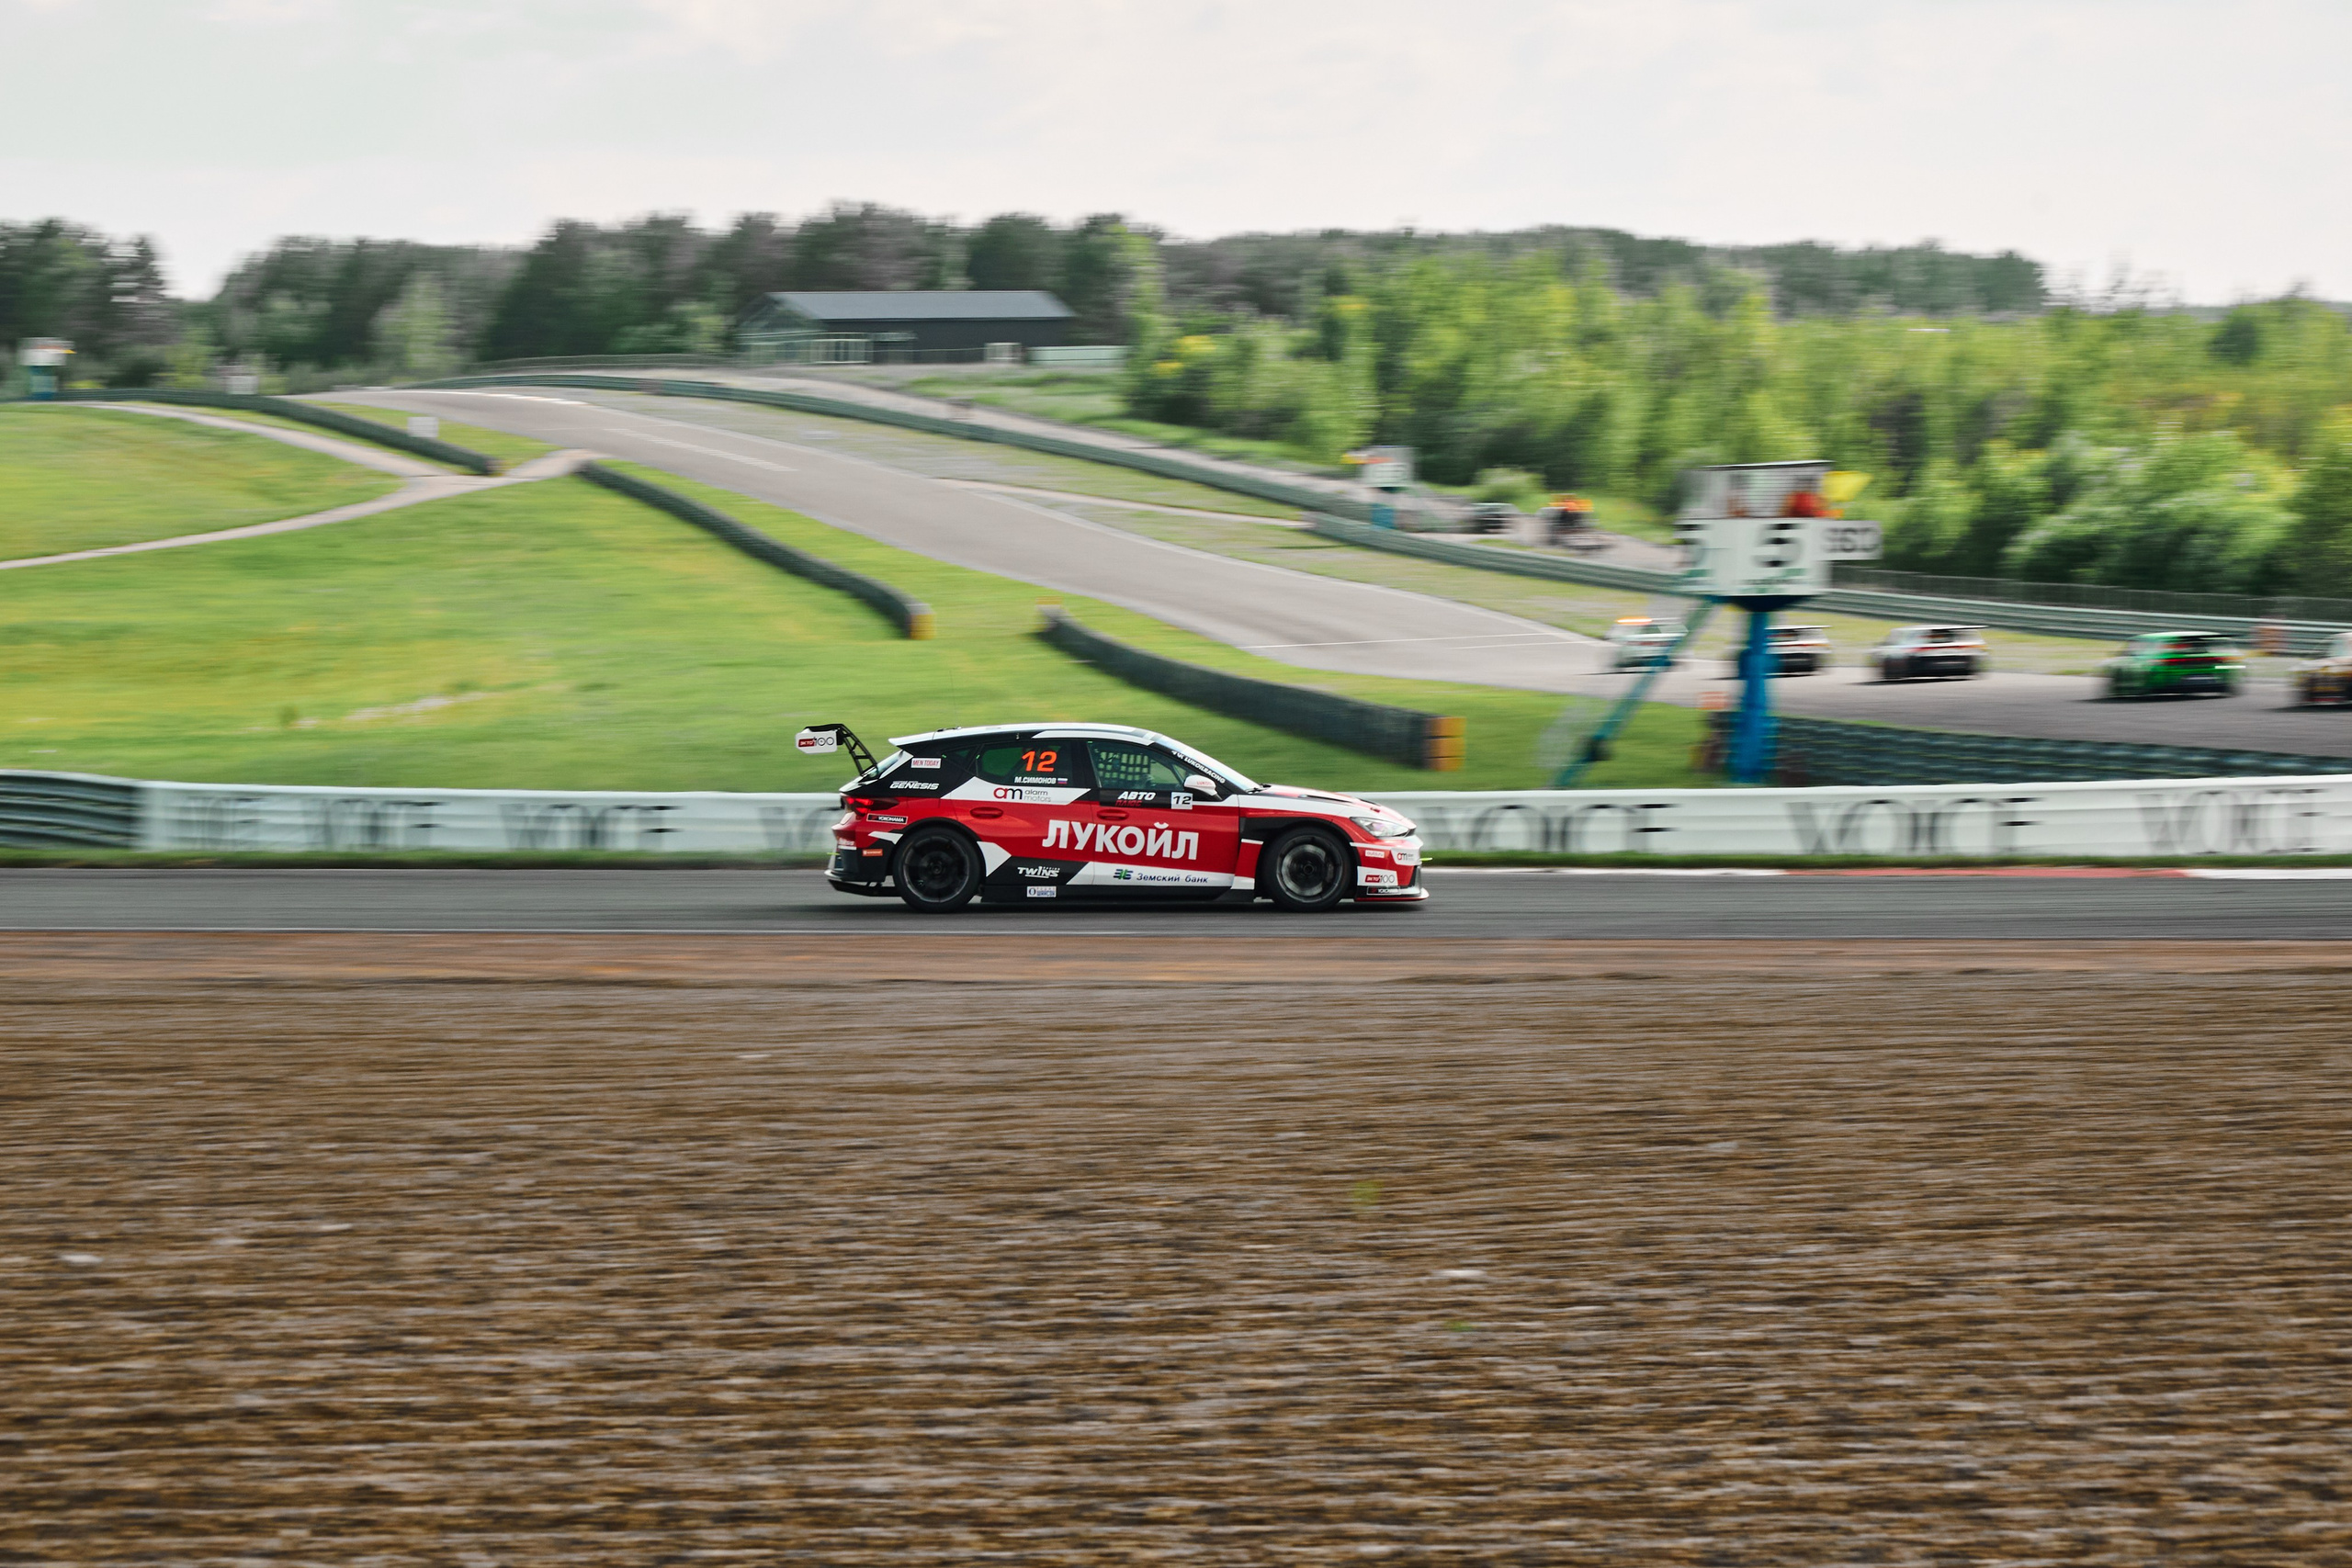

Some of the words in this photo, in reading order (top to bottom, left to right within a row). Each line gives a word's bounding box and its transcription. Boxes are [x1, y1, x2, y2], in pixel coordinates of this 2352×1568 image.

[1022, 750, 1057, 772] 12
[889, 781, 940, 790] GENESIS
[1117, 791, 1156, 800] АВТО
[1172, 795, 1192, 805] 12
[1042, 819, 1199, 861] ЛУКОЙЛ
[1136, 873, 1180, 882] Земский
[1184, 874, 1208, 883] банк
